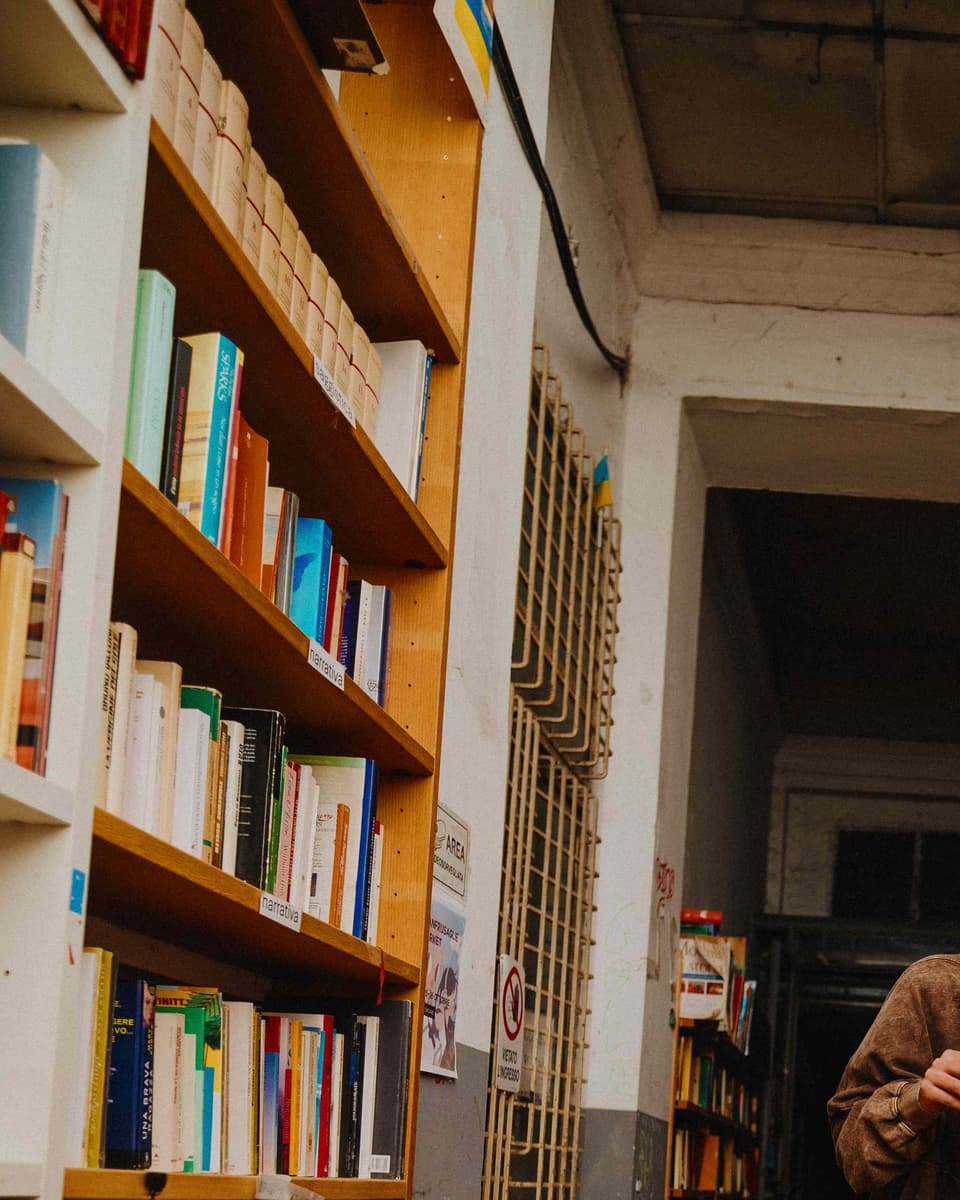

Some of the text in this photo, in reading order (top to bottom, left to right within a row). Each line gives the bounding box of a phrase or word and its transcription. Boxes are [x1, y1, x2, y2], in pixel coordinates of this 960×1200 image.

[218, 349, 232, 402] SPARKS
[309, 647, 344, 687] narrativa
[446, 834, 465, 864] AREA
[262, 896, 300, 925] narrativa
